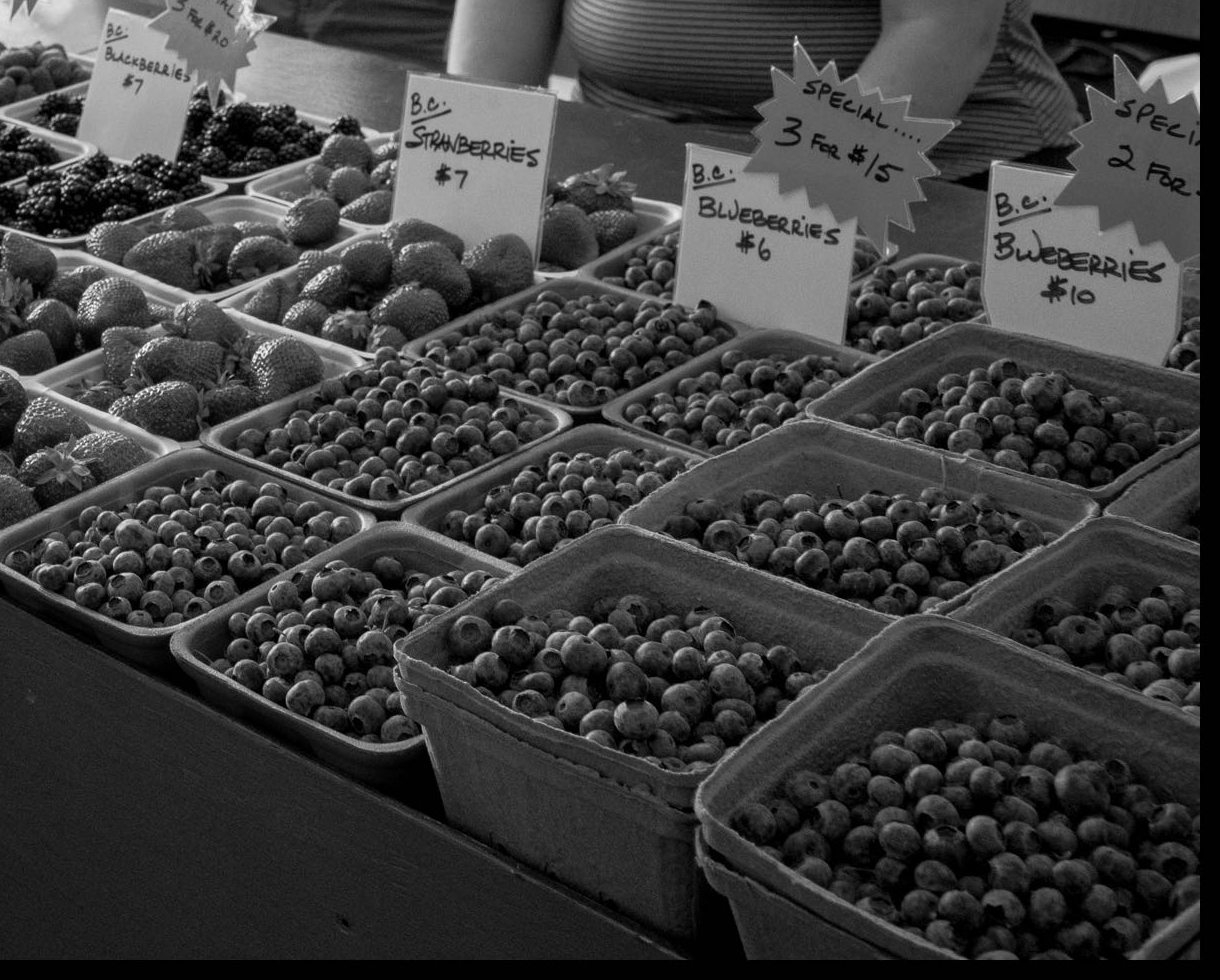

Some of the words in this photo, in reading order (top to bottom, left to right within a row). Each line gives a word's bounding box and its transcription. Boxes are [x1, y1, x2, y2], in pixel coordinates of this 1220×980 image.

[186, 7, 204, 31] FOR
[204, 19, 229, 49] $20
[104, 45, 192, 83] BLACKBERRIES
[122, 73, 145, 96] $7
[1115, 99, 1200, 147] SPECI
[774, 116, 804, 146] 3
[810, 133, 842, 161] FOR
[847, 143, 904, 183] $15
[435, 162, 468, 189] $7
[1107, 144, 1136, 171] 2
[1146, 161, 1192, 197] FOR
[697, 195, 841, 245] BLUEBERRIES
[735, 230, 772, 262] $6
[1040, 275, 1096, 306] $10
